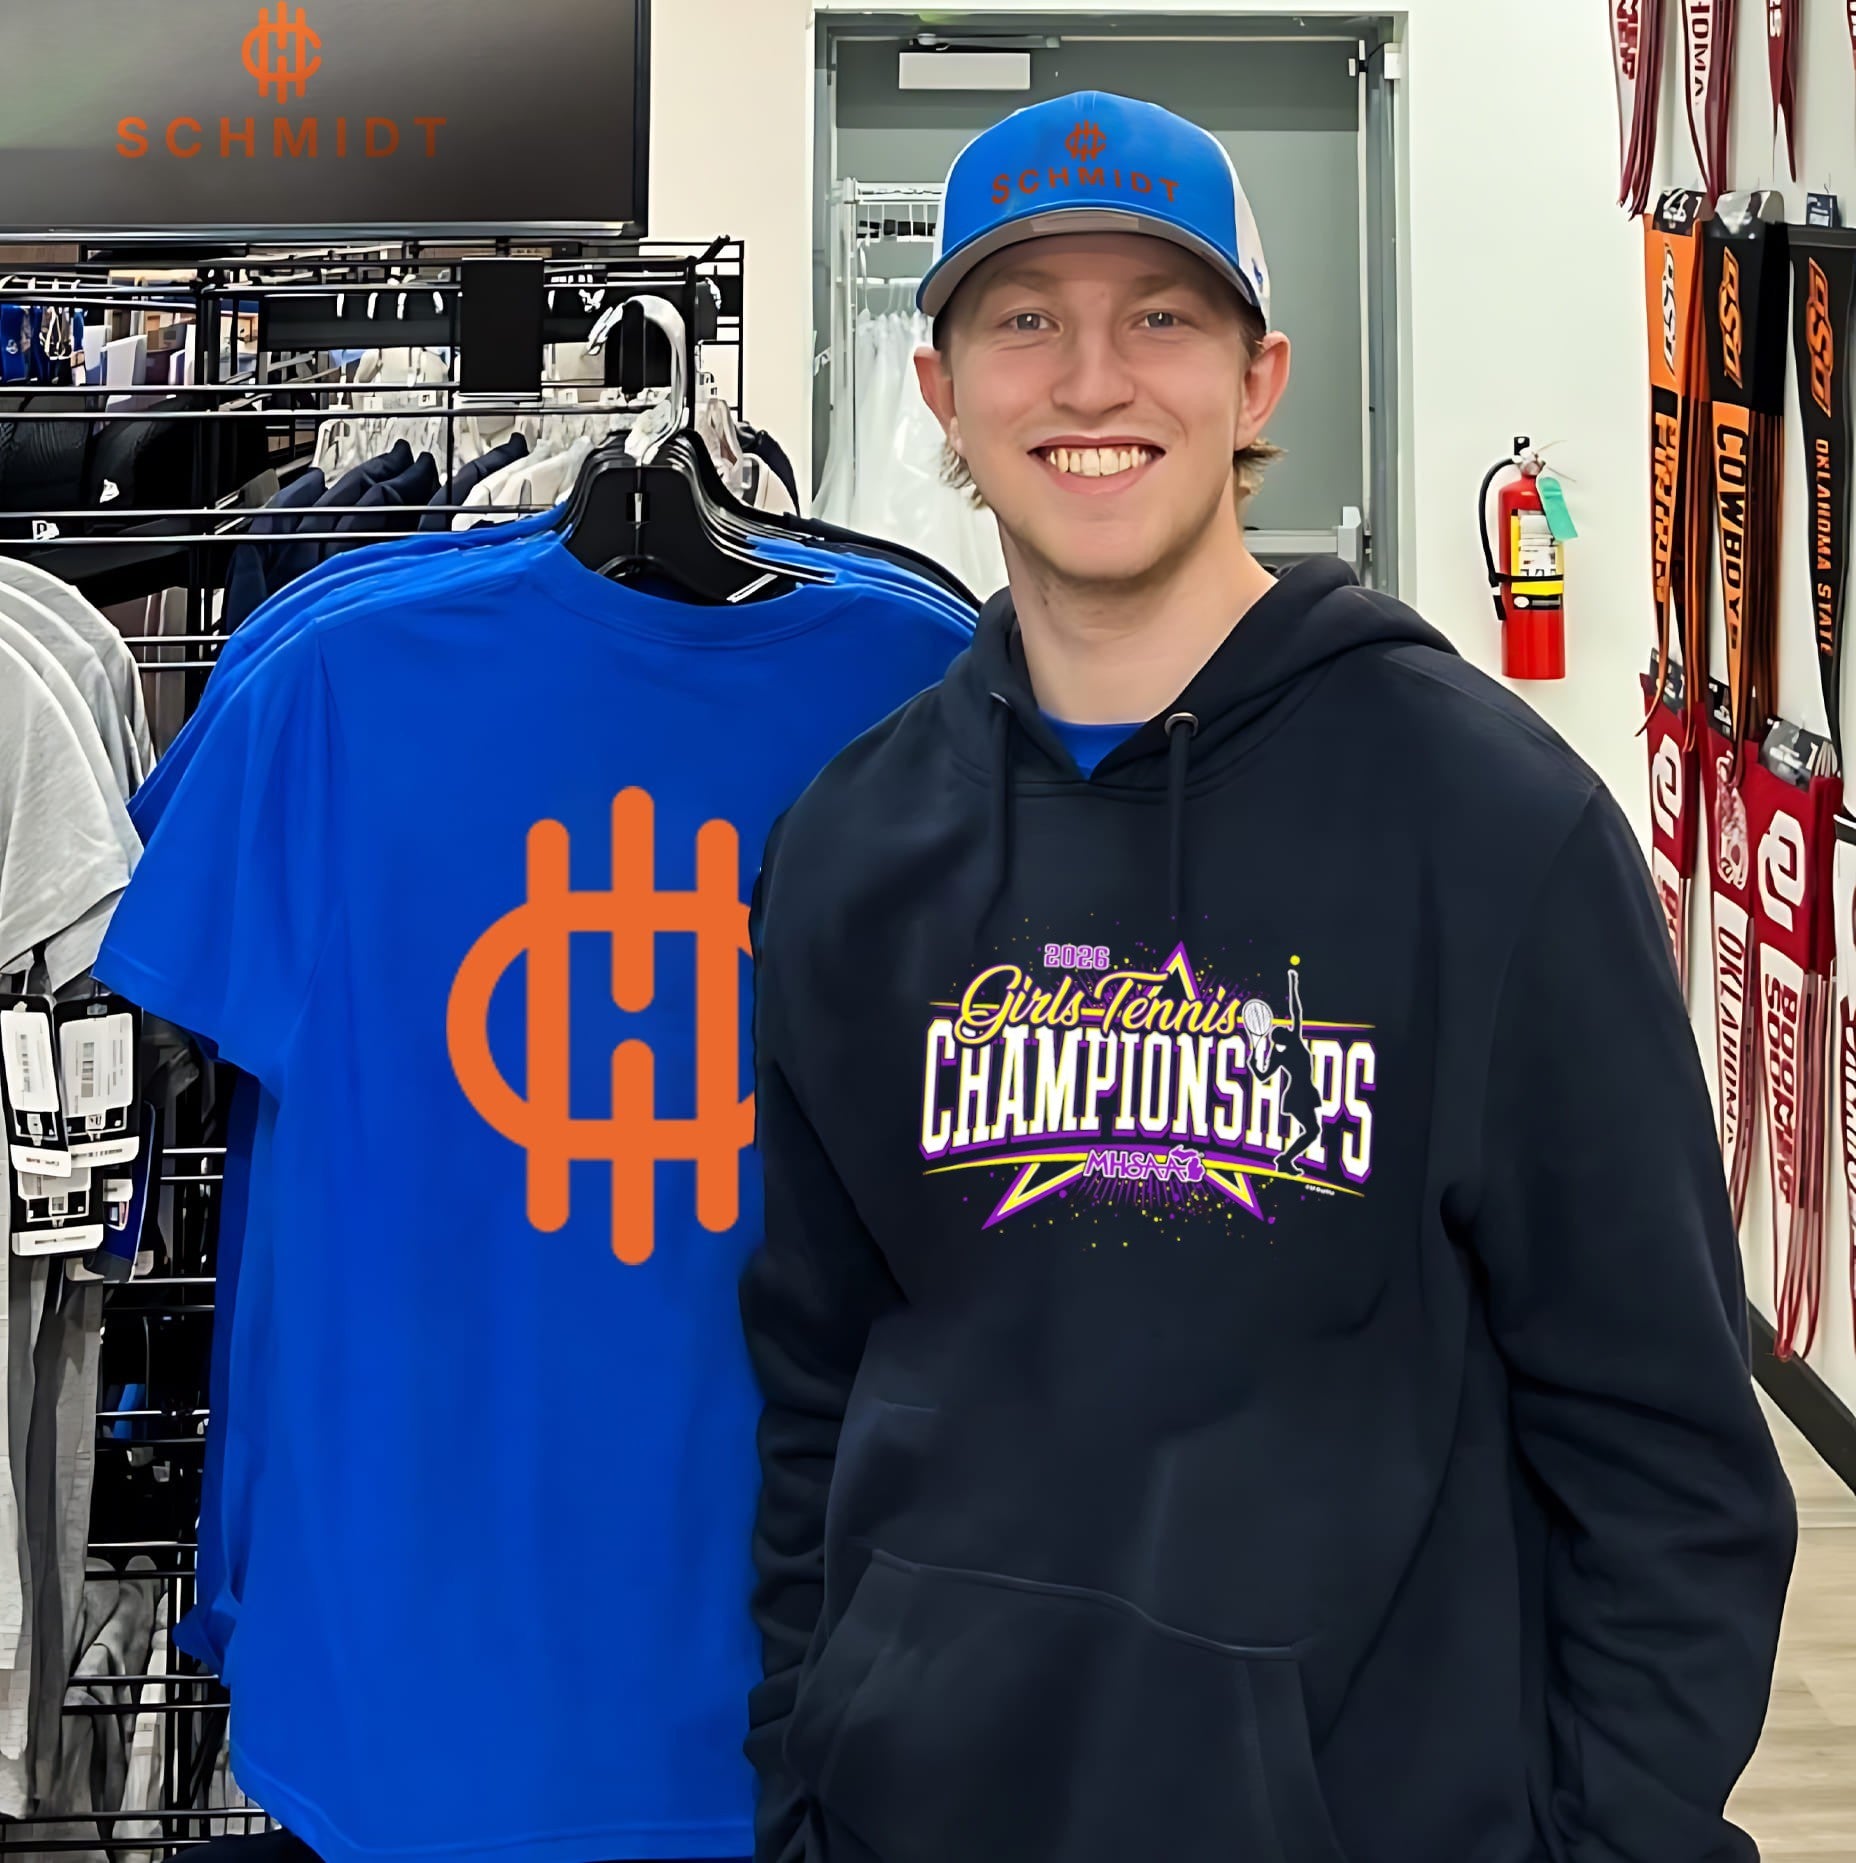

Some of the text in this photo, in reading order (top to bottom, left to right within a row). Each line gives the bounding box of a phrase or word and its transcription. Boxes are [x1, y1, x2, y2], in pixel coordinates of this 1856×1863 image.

[116, 117, 448, 158] SCHMIDT
[991, 167, 1179, 205] SCHMIDT
[1815, 439, 1832, 570] OKLAHOMA
[1043, 943, 1110, 971] 2026
[954, 965, 1241, 1044] Girls Tennis
[1718, 926, 1745, 1143] OKLAHOMA
[922, 1017, 1377, 1181] CHAMPIONSHPS
[1083, 1148, 1188, 1182] MHSAA
